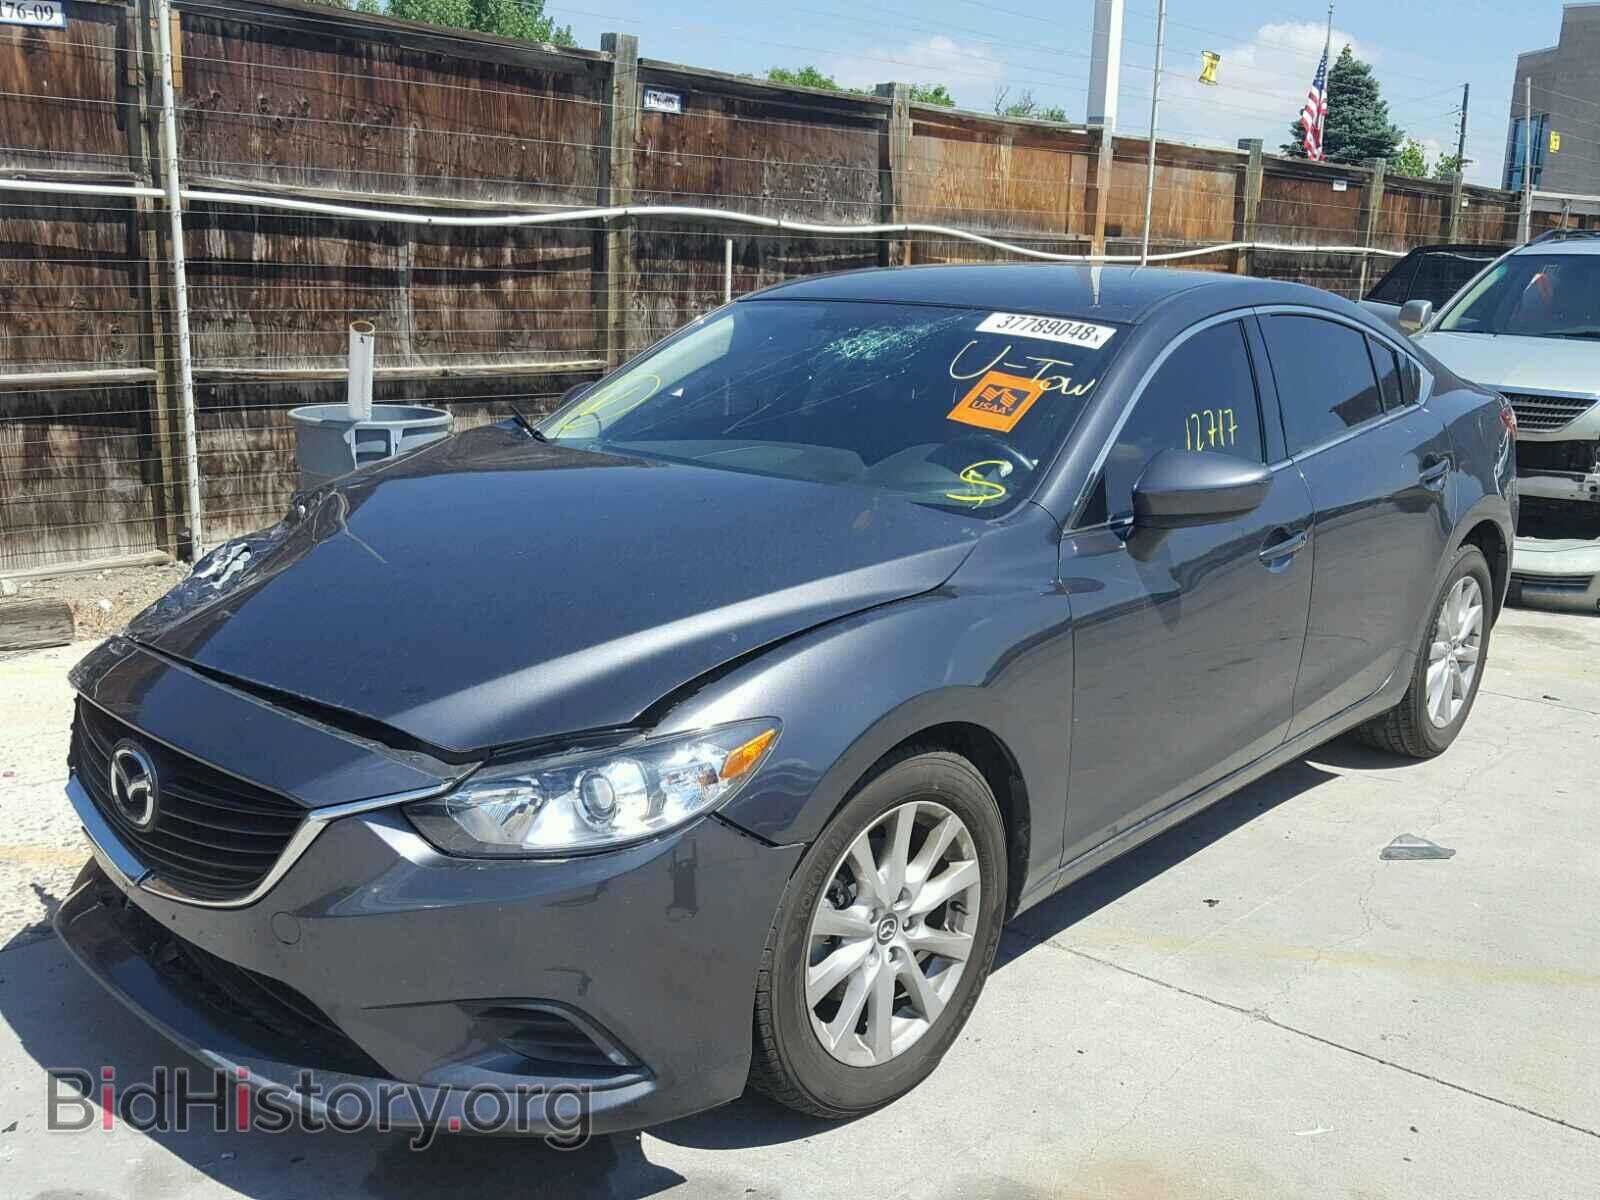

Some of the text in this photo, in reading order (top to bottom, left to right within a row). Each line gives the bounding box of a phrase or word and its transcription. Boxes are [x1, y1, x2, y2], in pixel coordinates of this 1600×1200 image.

[996, 316, 1096, 341] 37789048
[971, 400, 1007, 414] USAA
[1185, 408, 1238, 451] 12717
